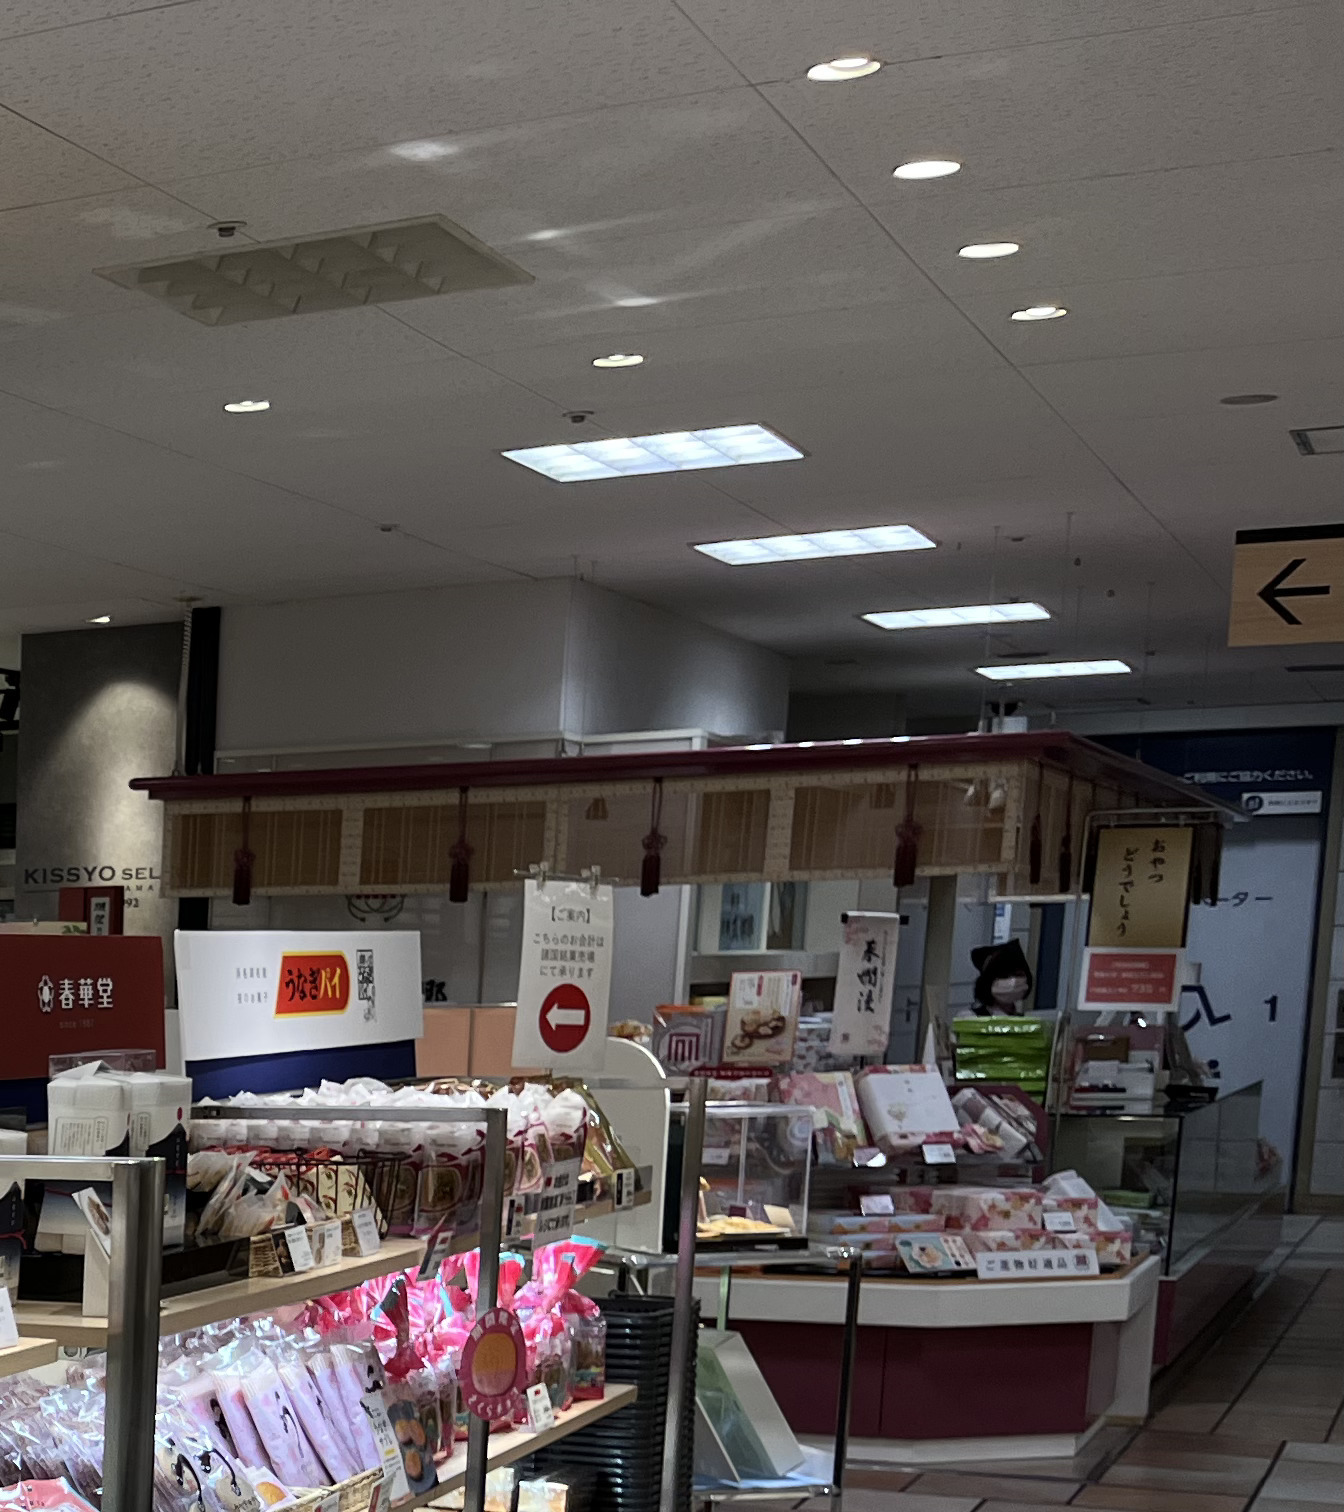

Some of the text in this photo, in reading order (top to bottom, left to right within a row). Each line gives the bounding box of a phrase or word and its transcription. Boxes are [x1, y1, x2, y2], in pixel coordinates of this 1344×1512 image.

[24, 865, 116, 884] KISSYO
[58, 977, 114, 1009] 春華堂
[285, 967, 341, 1002] うなぎパイ
